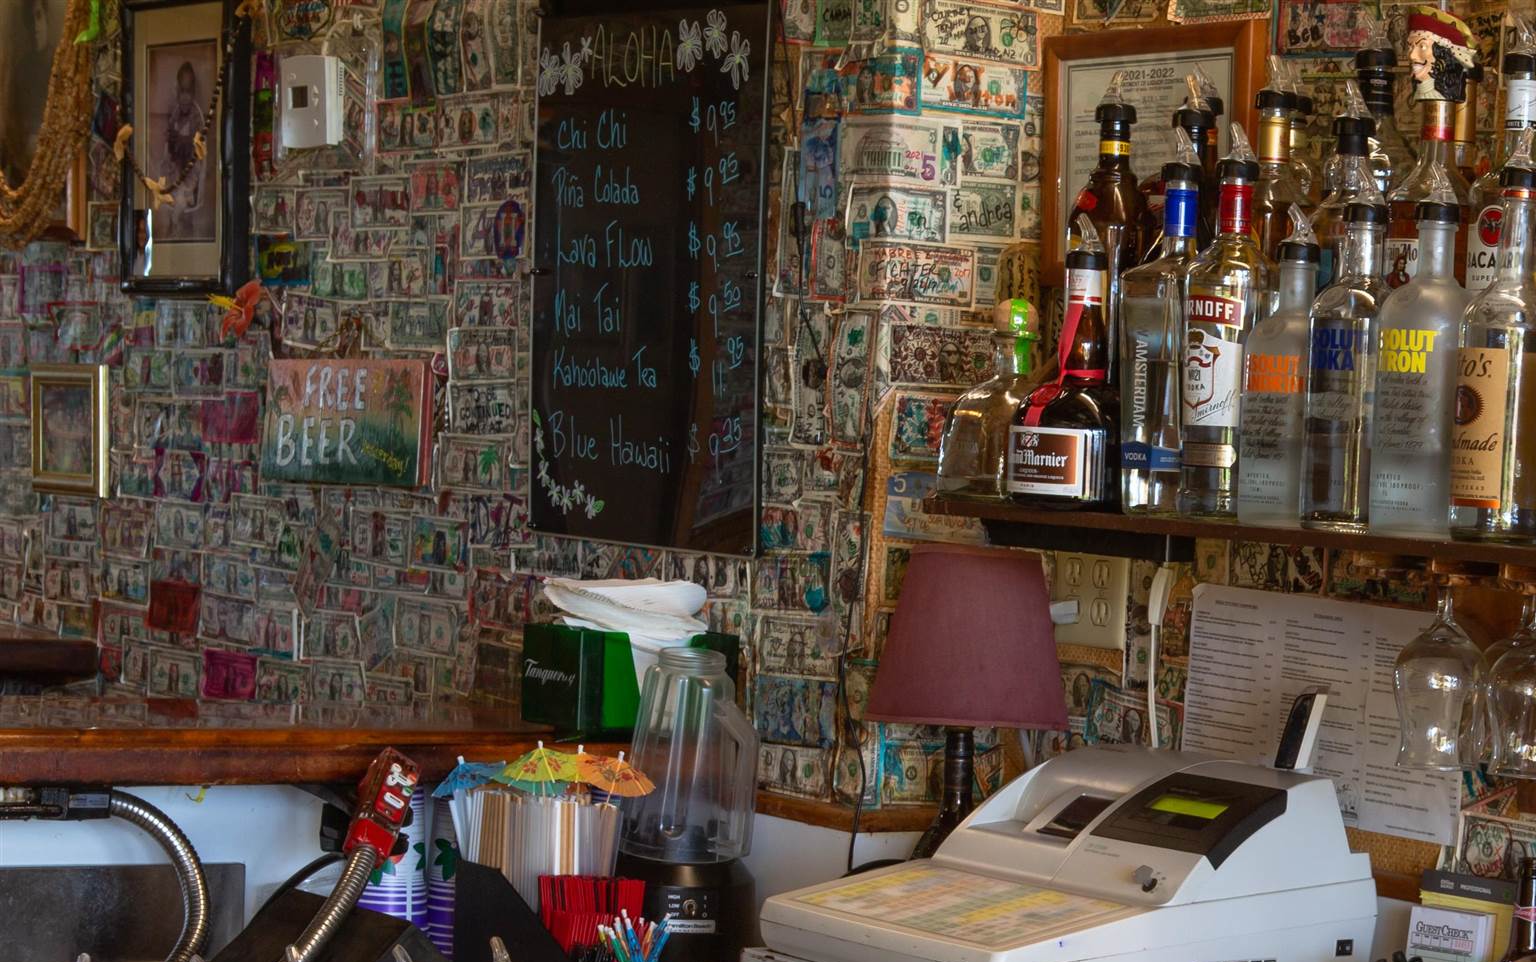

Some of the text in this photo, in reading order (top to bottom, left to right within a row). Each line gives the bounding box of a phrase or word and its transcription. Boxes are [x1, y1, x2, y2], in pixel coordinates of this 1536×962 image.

[591, 23, 675, 88] ALOHA
[1122, 67, 1175, 81] 2021-2022
[557, 117, 588, 150] Chi
[597, 108, 627, 149] Chi
[594, 164, 640, 205] Colada
[556, 224, 597, 268] Lava
[594, 282, 621, 334] Tai
[1187, 296, 1235, 322] RNOFF
[1379, 329, 1438, 352] SOLUT
[632, 345, 657, 389] Tea
[1456, 352, 1492, 379] ito's.
[303, 365, 369, 412] FREE
[275, 412, 360, 467] BEER
[548, 410, 599, 461] Blue
[609, 413, 670, 474] Hawaii
[1022, 449, 1068, 468] Marnier
[1124, 451, 1147, 462] VODKA
[1416, 921, 1469, 940] GUEST CHECK
